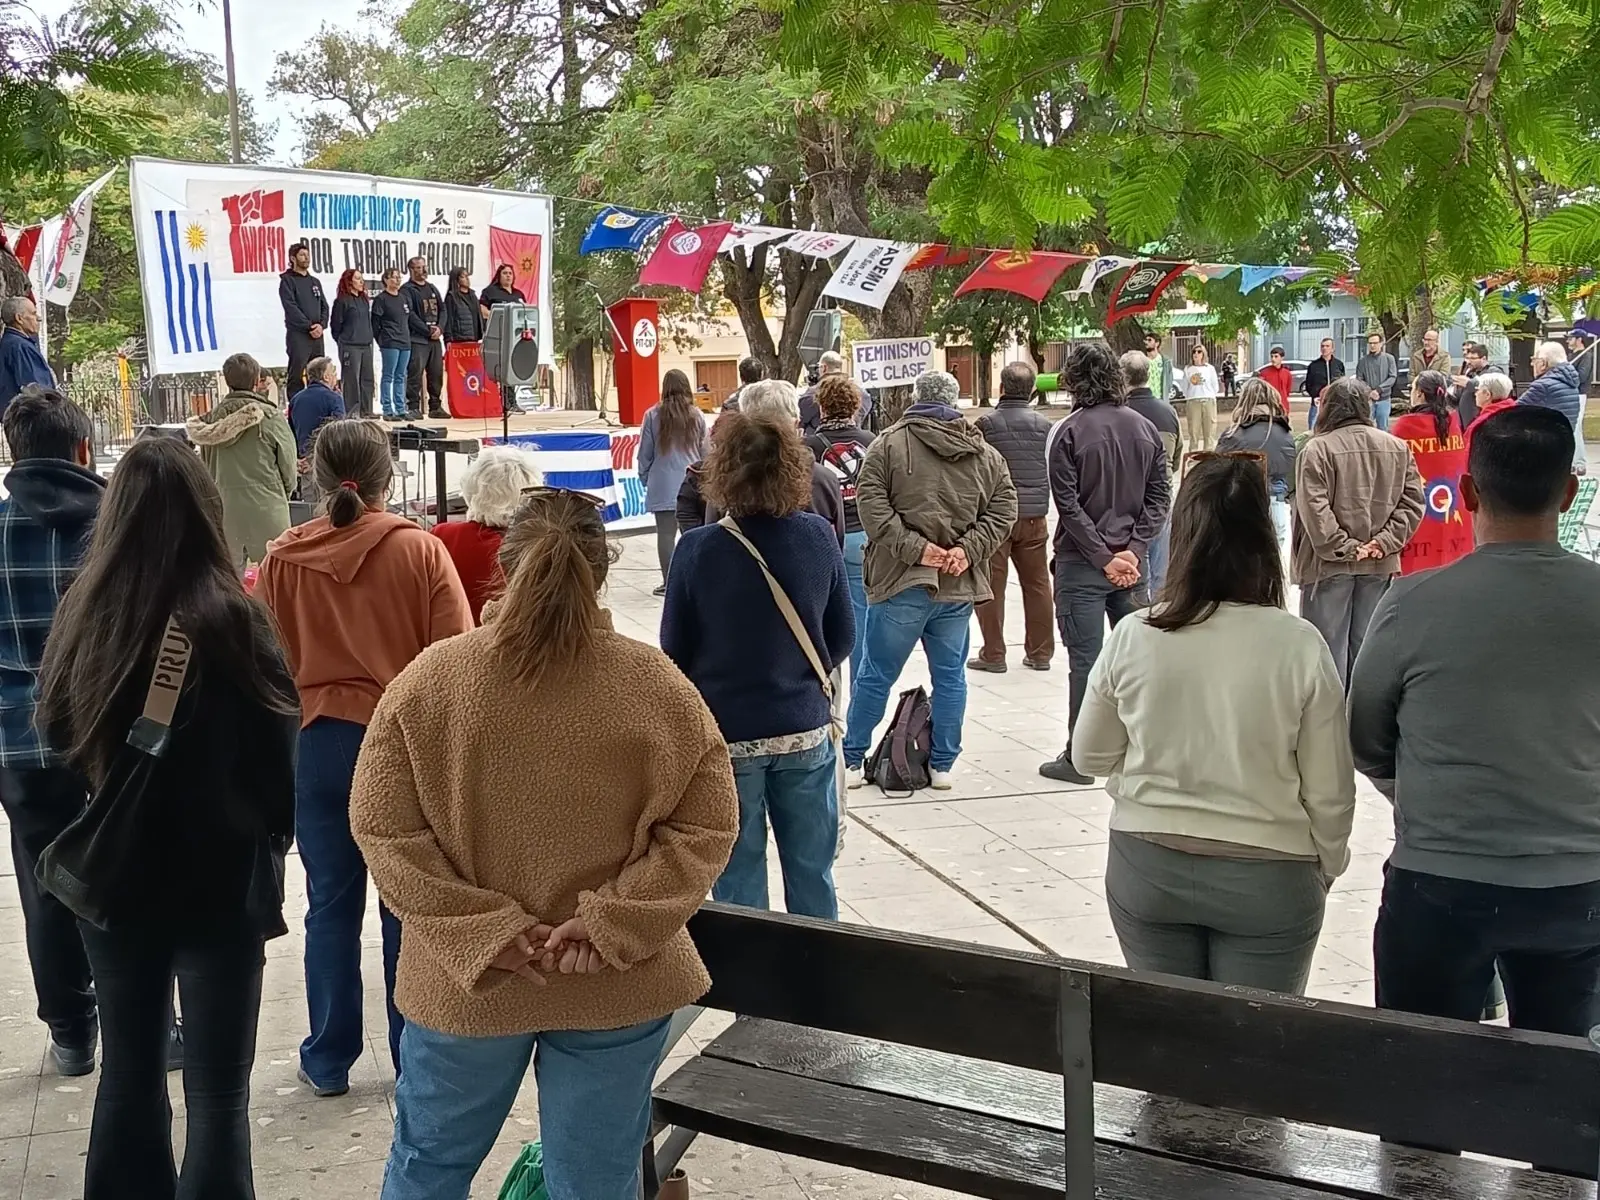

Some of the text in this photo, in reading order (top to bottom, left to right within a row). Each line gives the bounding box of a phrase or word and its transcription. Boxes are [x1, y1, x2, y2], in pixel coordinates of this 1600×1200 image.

[241, 225, 286, 273] MAYO
[300, 236, 334, 274] OR
[860, 246, 900, 293] ADEMU
[635, 338, 656, 348] PIT-CNT
[855, 340, 932, 363] FEMINISMO
[861, 368, 879, 383] DE
[154, 625, 190, 690] PRU
